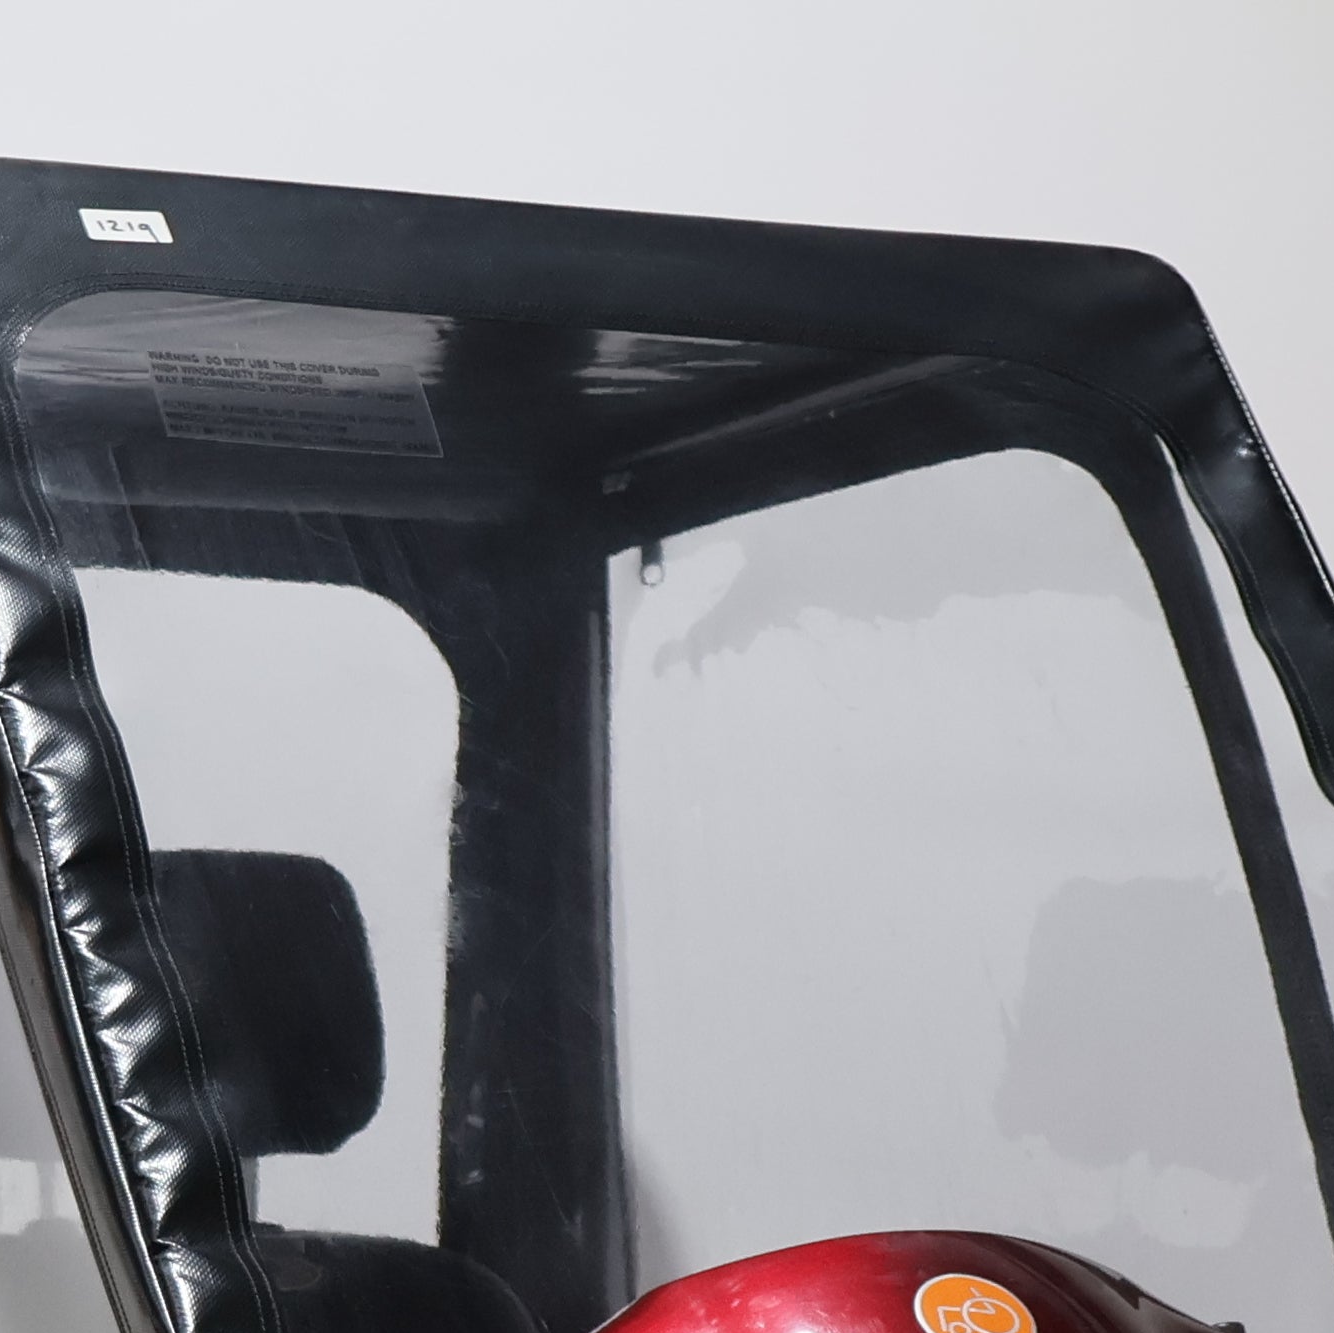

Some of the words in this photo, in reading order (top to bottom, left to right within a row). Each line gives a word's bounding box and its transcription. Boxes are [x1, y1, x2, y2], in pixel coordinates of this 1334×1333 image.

[96, 219, 159, 243] 1219
[205, 355, 222, 366] DO
[223, 358, 245, 368] NOT
[273, 360, 297, 371] THIS
[338, 366, 380, 377] DURING
